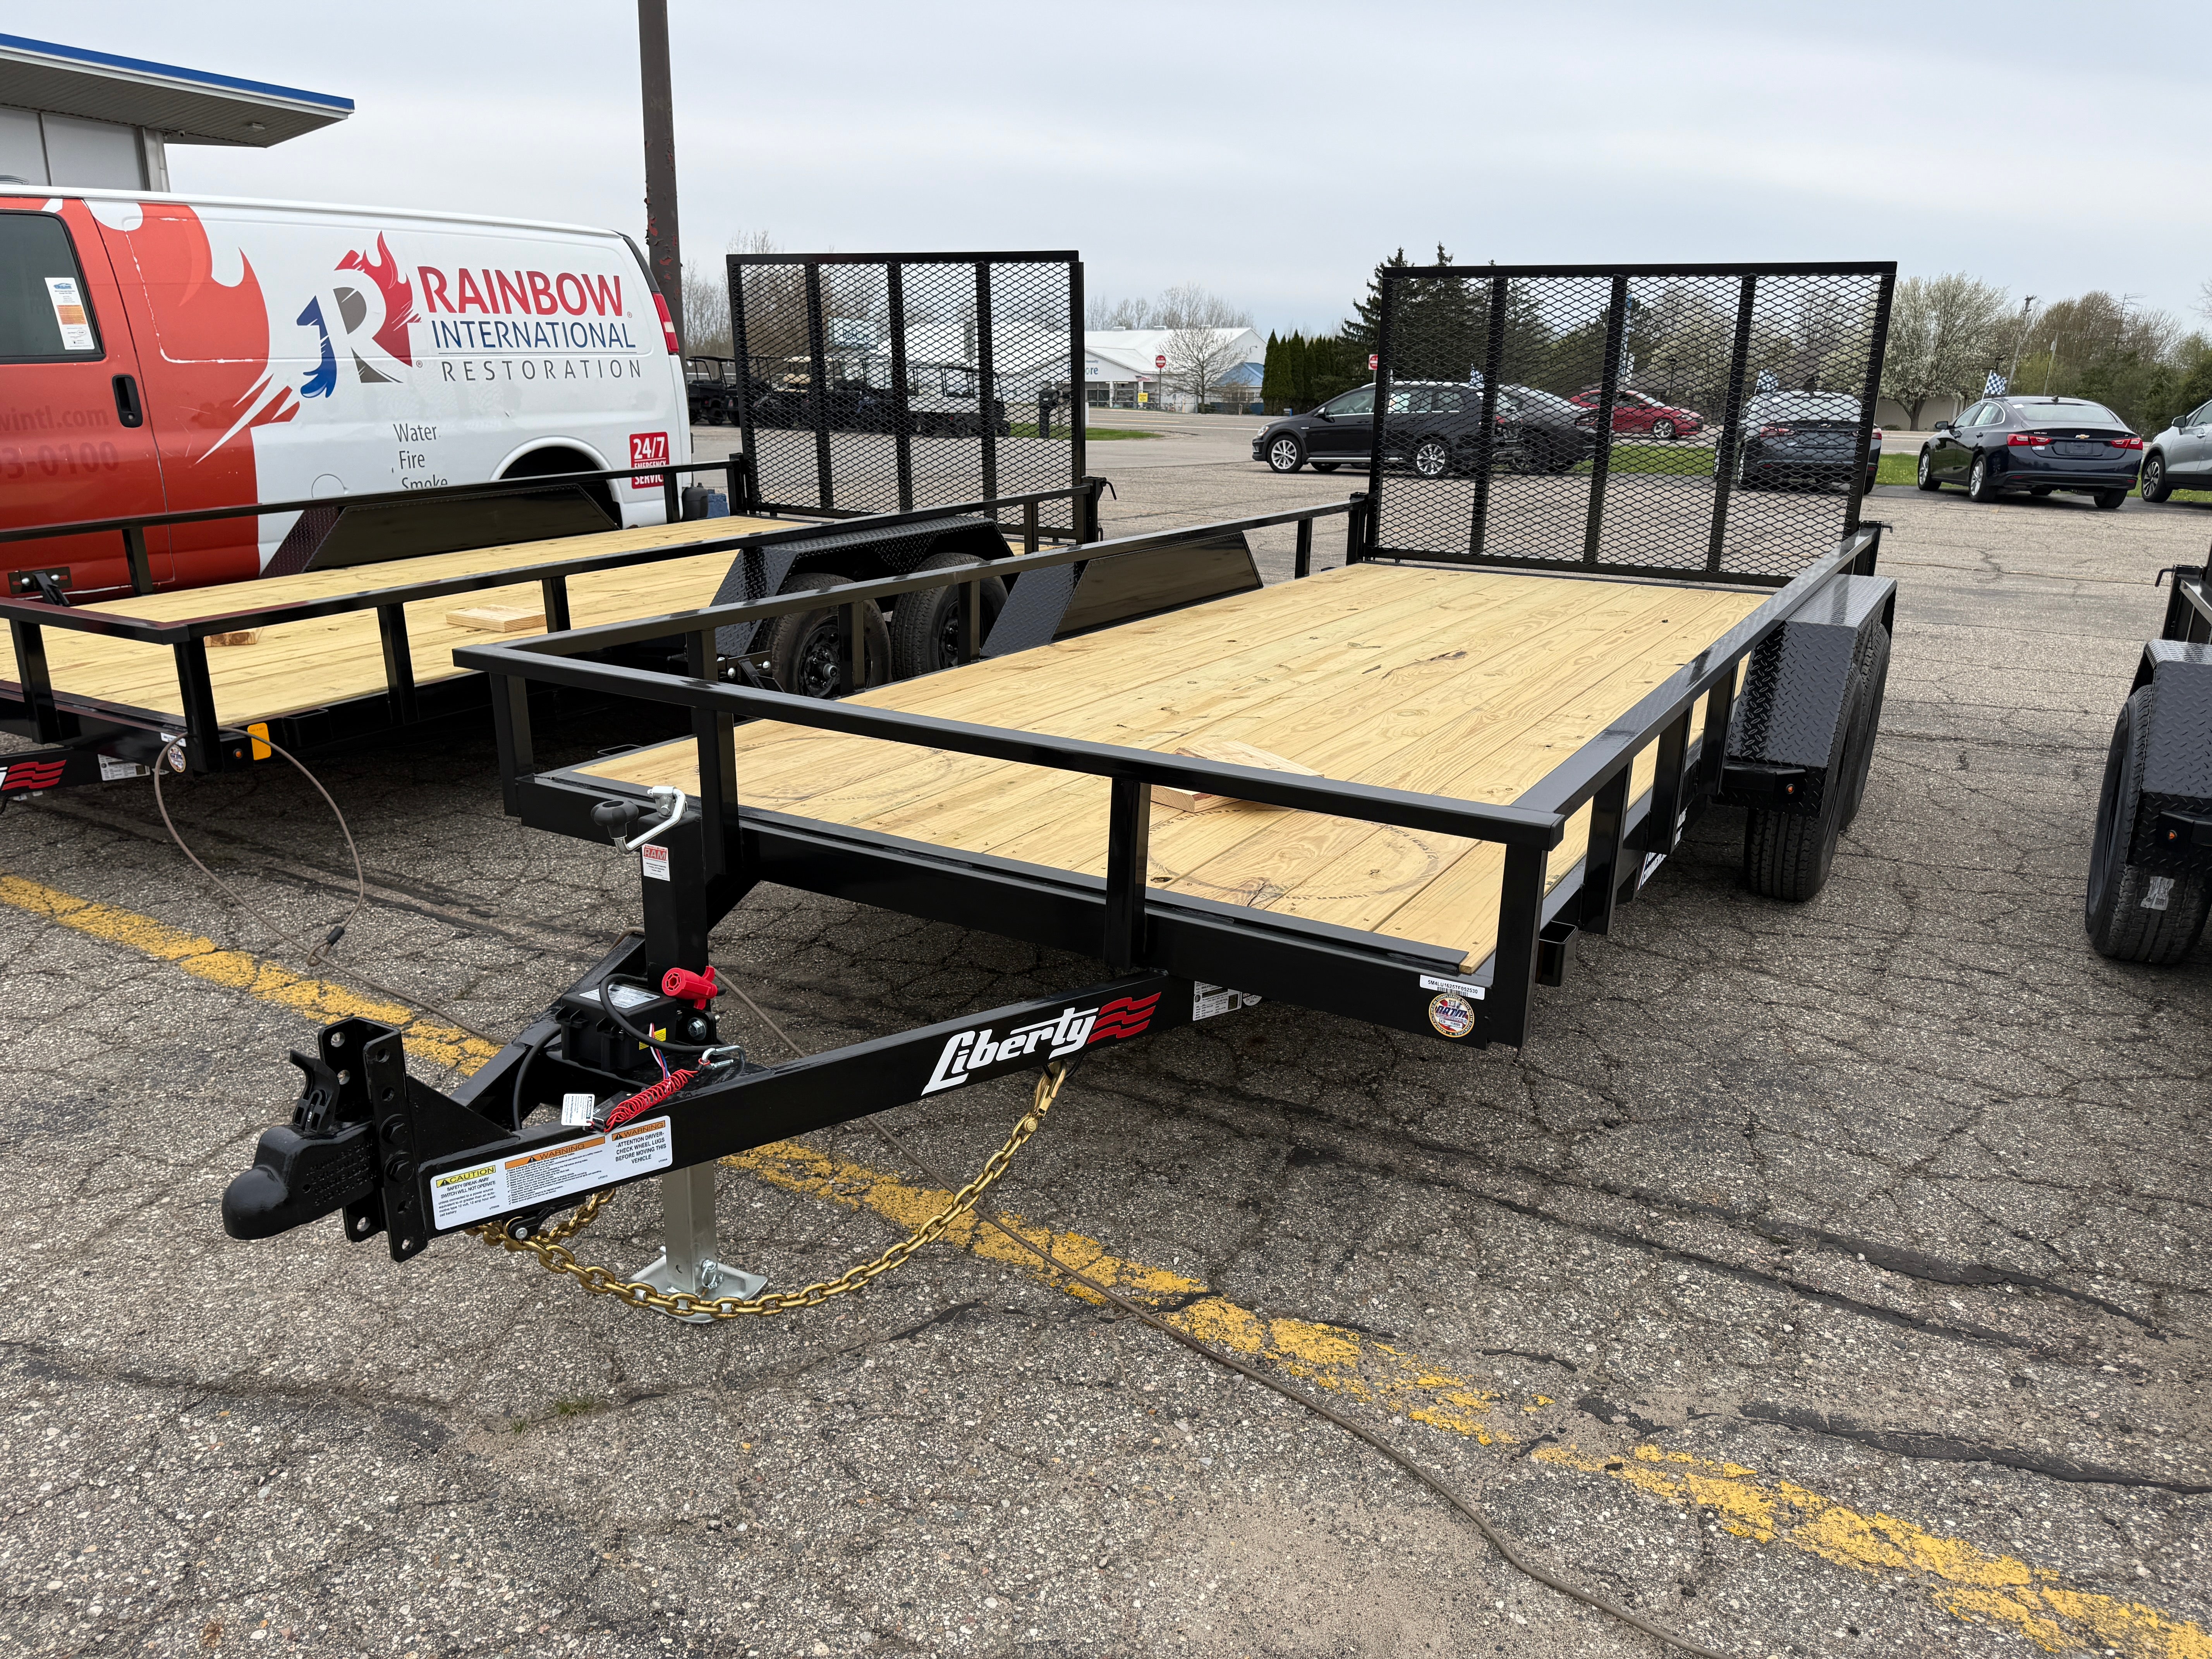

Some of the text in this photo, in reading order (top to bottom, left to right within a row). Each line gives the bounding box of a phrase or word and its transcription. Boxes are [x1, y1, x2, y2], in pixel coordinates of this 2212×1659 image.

[417, 266, 622, 316] RAINBOW
[432, 320, 636, 348] INTERNATIONAL
[442, 360, 641, 381] RESTORATION
[393, 423, 436, 442] Water
[634, 437, 665, 459] 24/7
[399, 451, 425, 469] Fire
[635, 474, 663, 485] SERVIC
[645, 848, 666, 860] RAM
[921, 1007, 1099, 1096] Liberty
[624, 1123, 663, 1137] WARNING
[540, 1143, 584, 1159] WARNING
[616, 1152, 635, 1161] BEFORE
[636, 1147, 654, 1156] MOVING
[617, 1145, 633, 1154] CHECK
[634, 1142, 651, 1150] WHEEL
[632, 1154, 651, 1164] VEHICLE
[450, 1167, 493, 1183] CAUTION
[464, 1177, 489, 1187] BREAK-AWAY
